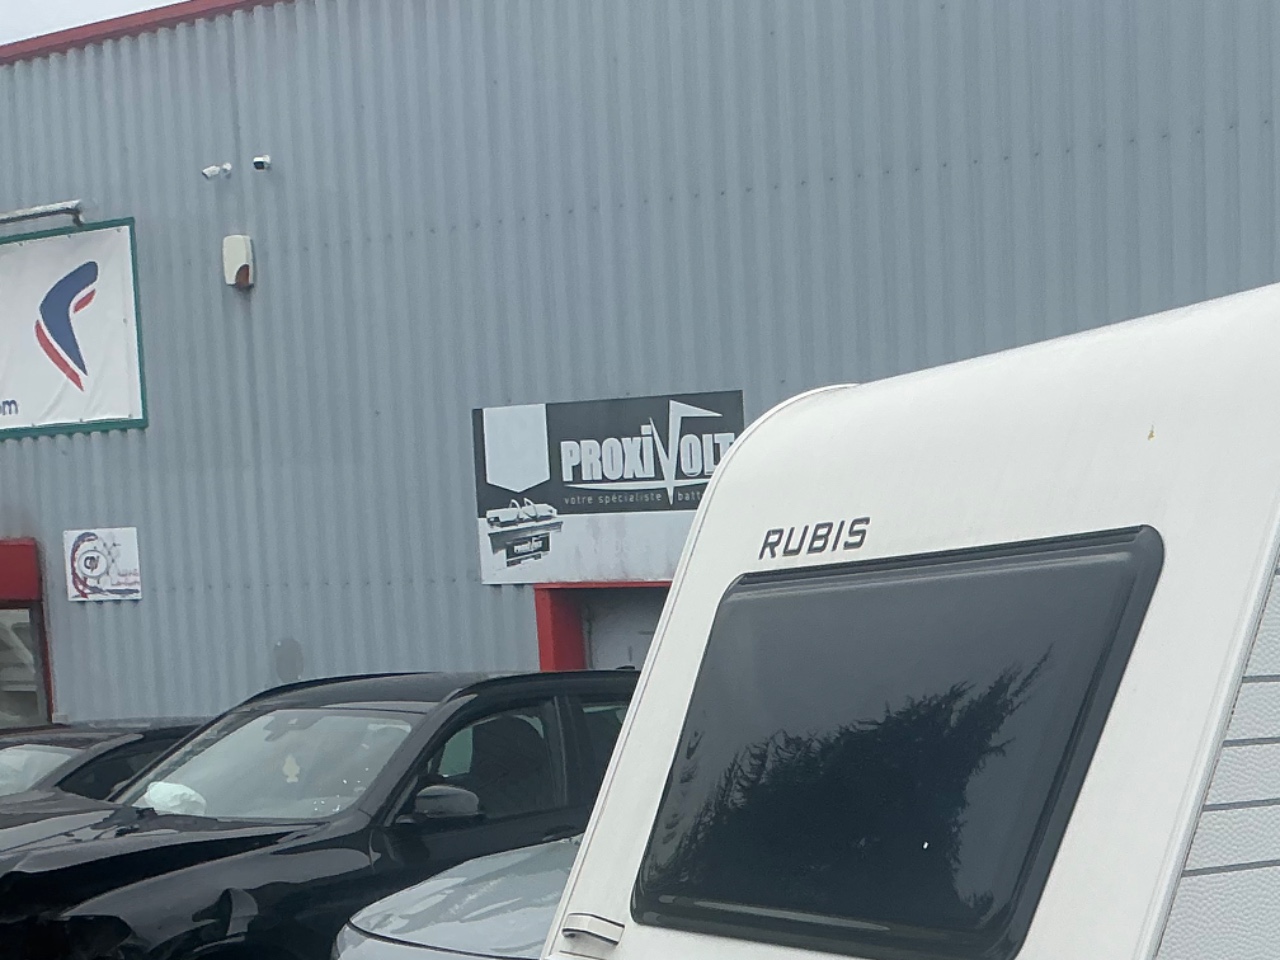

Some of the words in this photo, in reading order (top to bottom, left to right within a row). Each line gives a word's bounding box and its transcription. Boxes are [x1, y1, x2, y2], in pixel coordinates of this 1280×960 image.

[564, 495, 593, 505] votre
[598, 491, 662, 505] spécialiste
[758, 516, 871, 560] RUBIS
